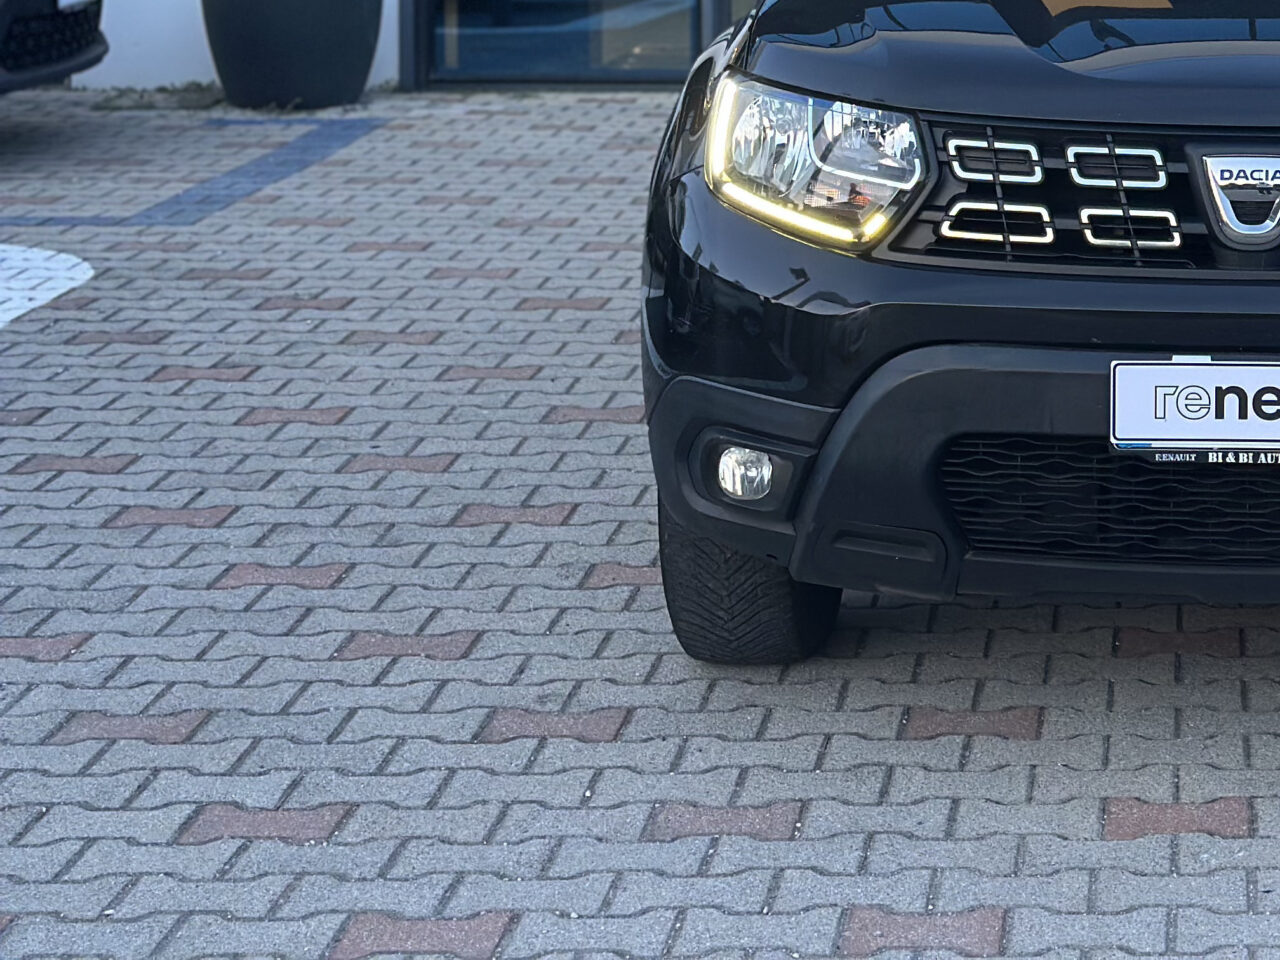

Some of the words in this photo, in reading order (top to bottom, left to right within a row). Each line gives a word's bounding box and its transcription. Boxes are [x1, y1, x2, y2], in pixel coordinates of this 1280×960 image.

[1155, 453, 1197, 462] RENAULT
[1208, 452, 1223, 463] BI
[1225, 452, 1236, 463] &
[1238, 452, 1254, 464] BI
